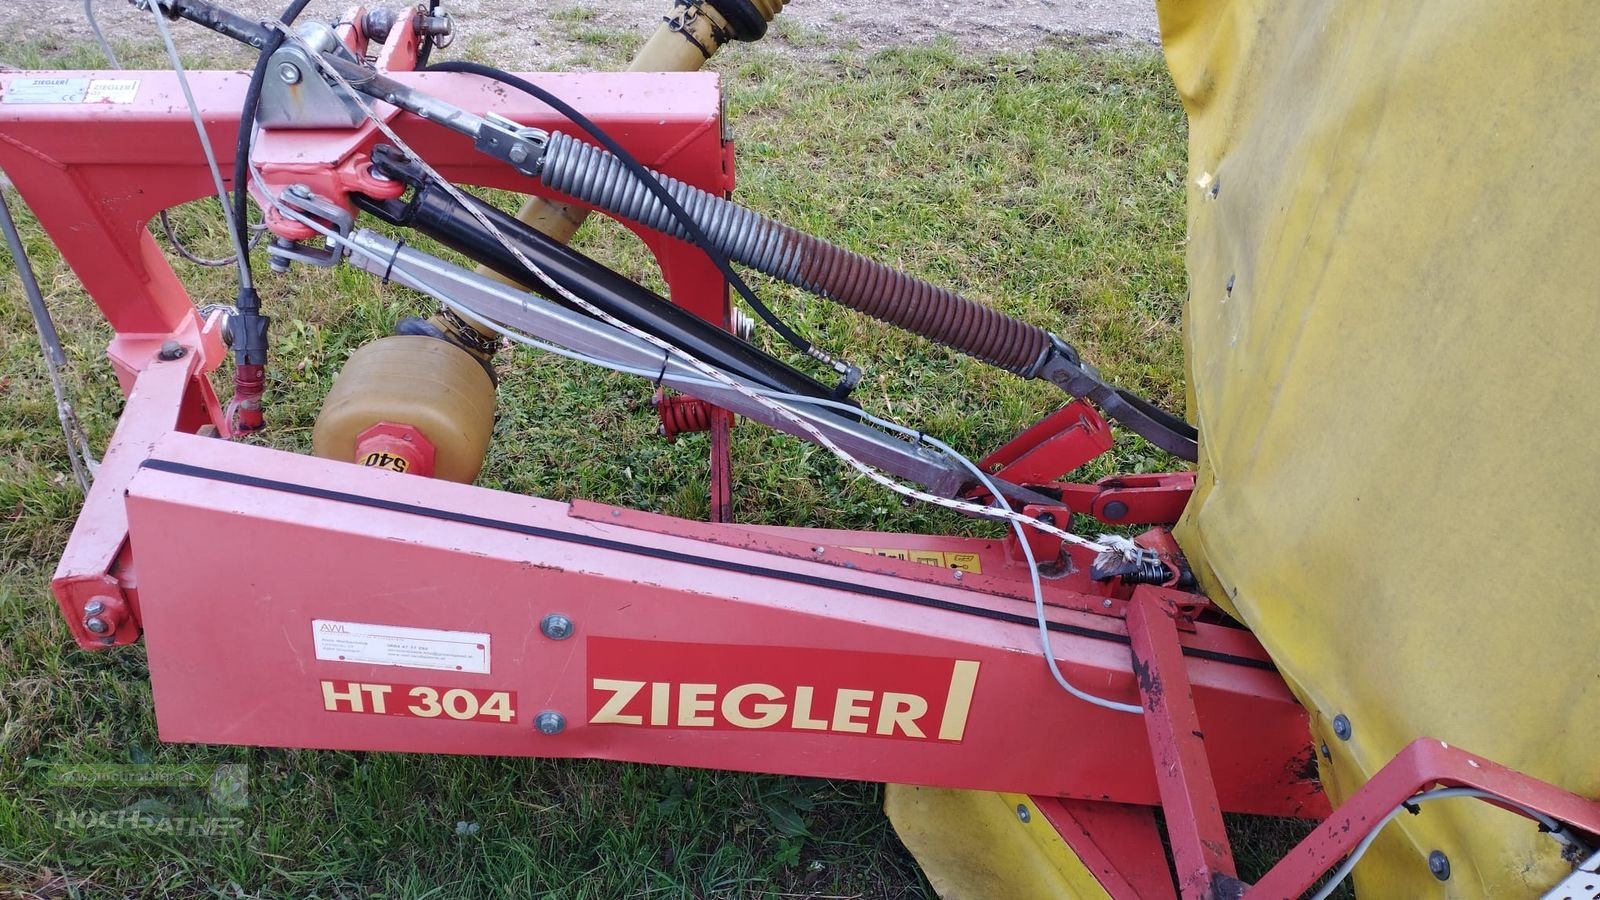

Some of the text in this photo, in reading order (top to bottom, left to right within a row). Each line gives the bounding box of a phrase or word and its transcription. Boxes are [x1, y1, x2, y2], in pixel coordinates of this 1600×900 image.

[364, 452, 408, 473] 540
[320, 623, 351, 634] AWL
[320, 680, 516, 723] HT 304
[588, 677, 928, 739] ZIEGLER
